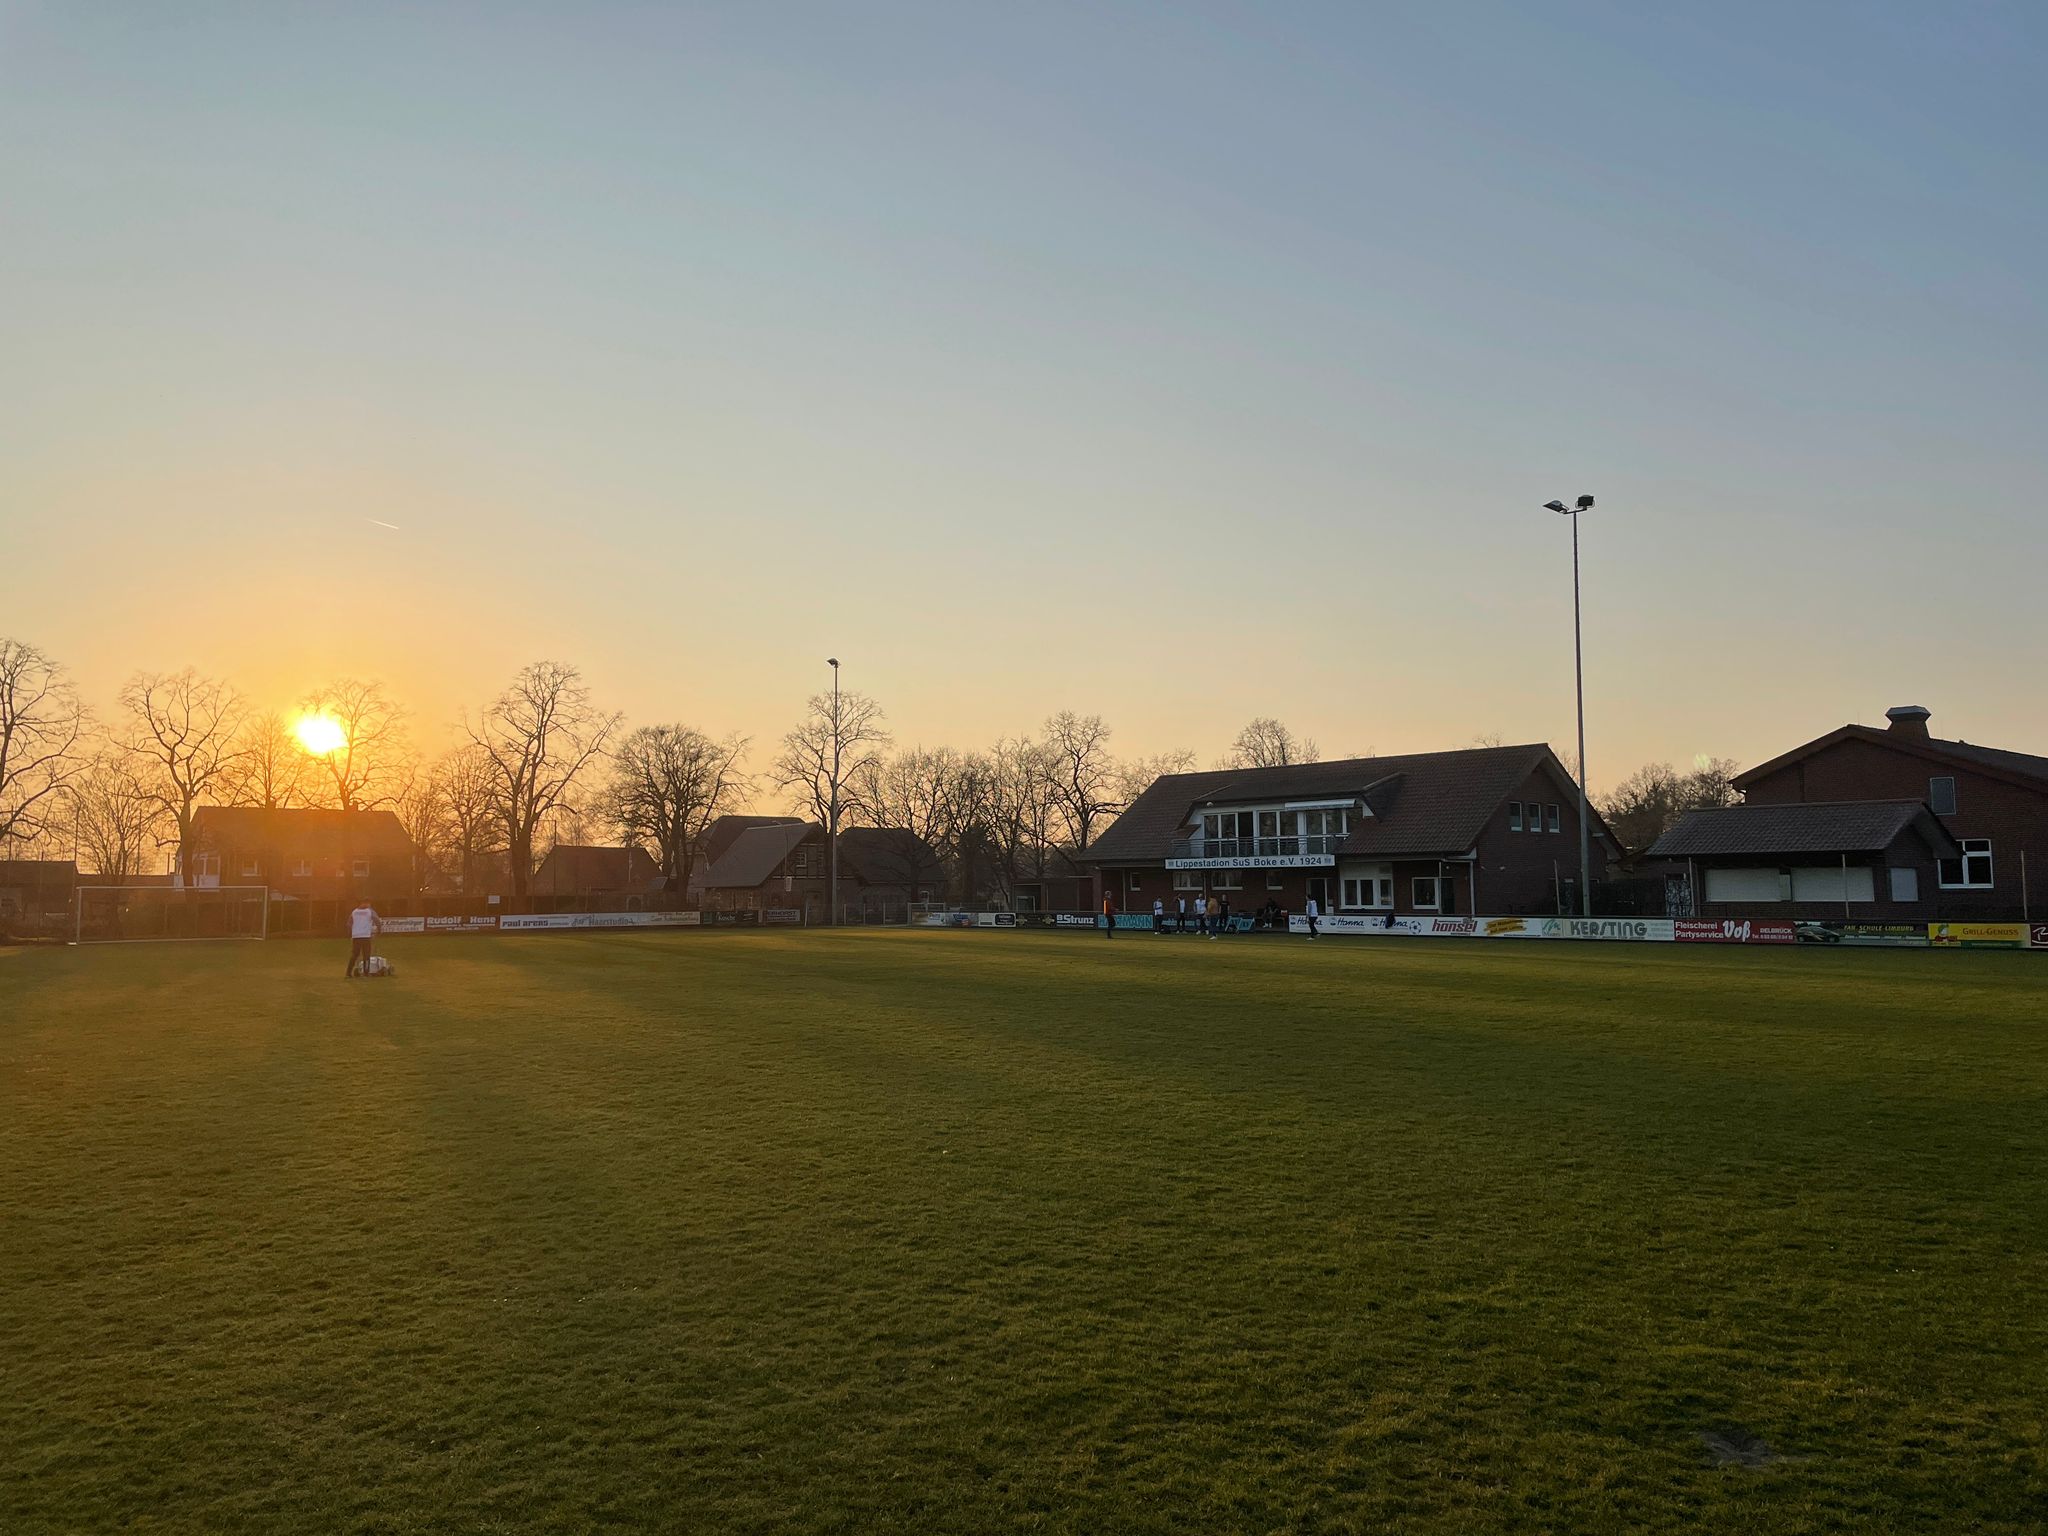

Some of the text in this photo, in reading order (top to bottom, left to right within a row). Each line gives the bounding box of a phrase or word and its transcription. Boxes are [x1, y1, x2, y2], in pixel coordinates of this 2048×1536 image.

[1175, 857, 1322, 869] Lippestadion SuS Boke e.V. 1924
[426, 916, 462, 924] Rudolf
[1675, 921, 1718, 929] Fleischerei
[1570, 920, 1648, 936] KERSTING
[1722, 920, 1751, 942] Voß
[1675, 930, 1724, 939] Partyservice
